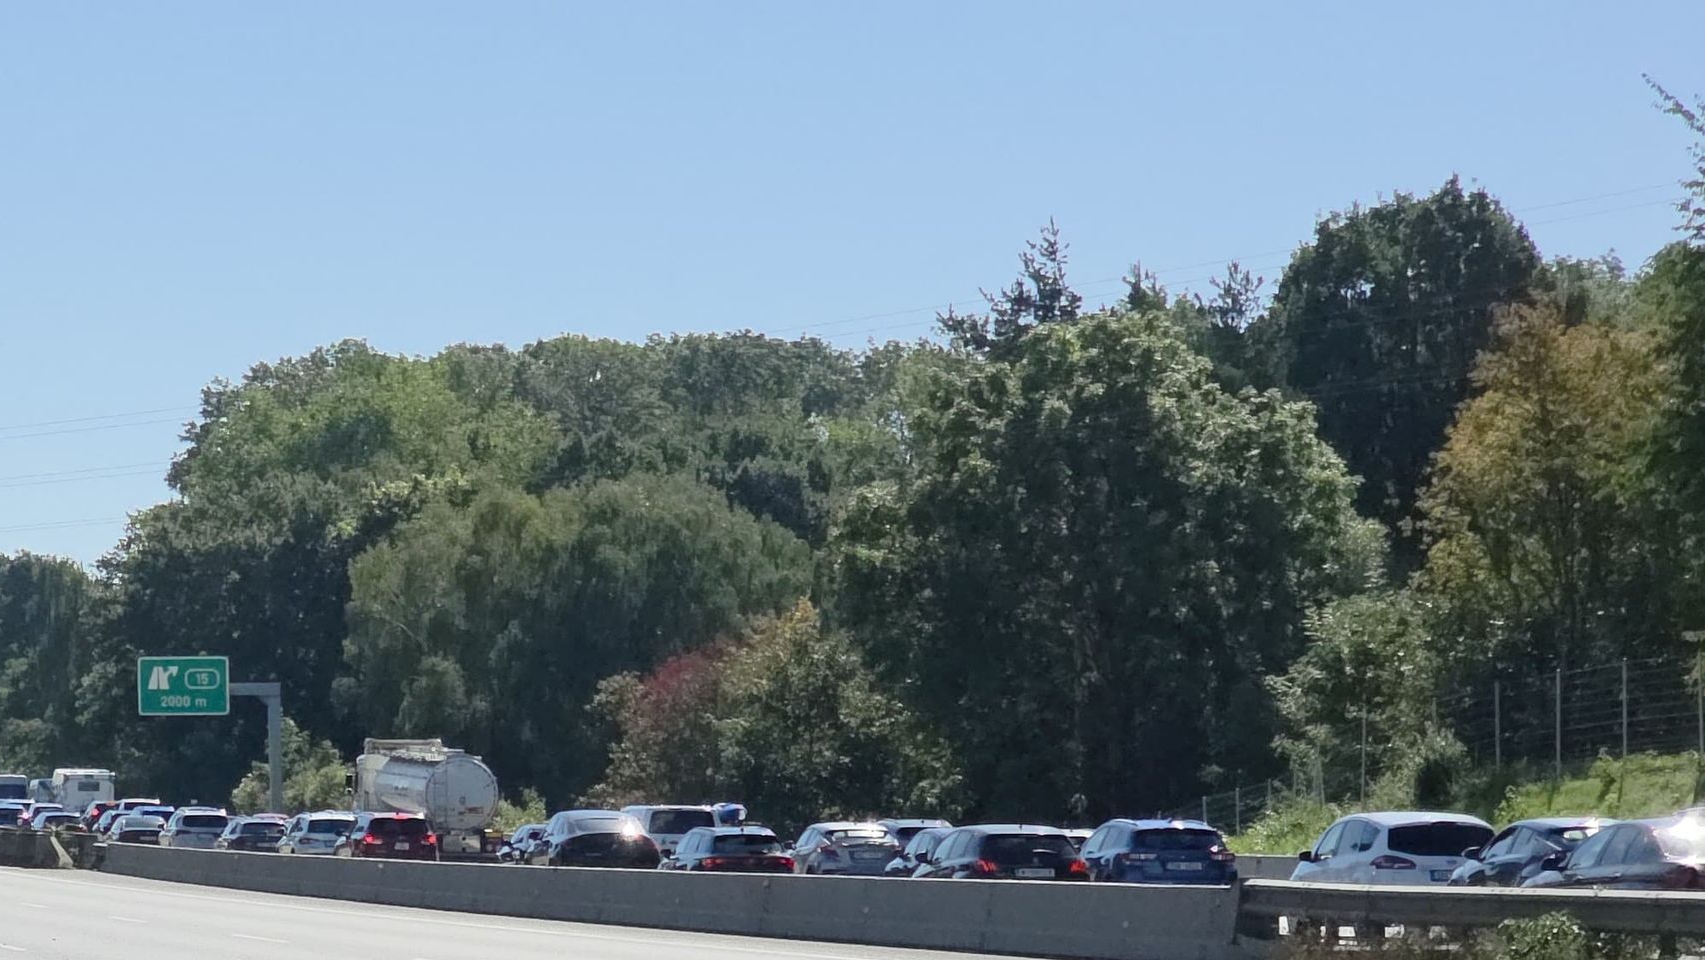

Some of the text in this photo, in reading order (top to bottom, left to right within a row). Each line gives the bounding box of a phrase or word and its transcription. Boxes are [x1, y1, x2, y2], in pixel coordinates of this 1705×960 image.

[196, 672, 209, 685] 15
[160, 695, 207, 708] 2000 m
